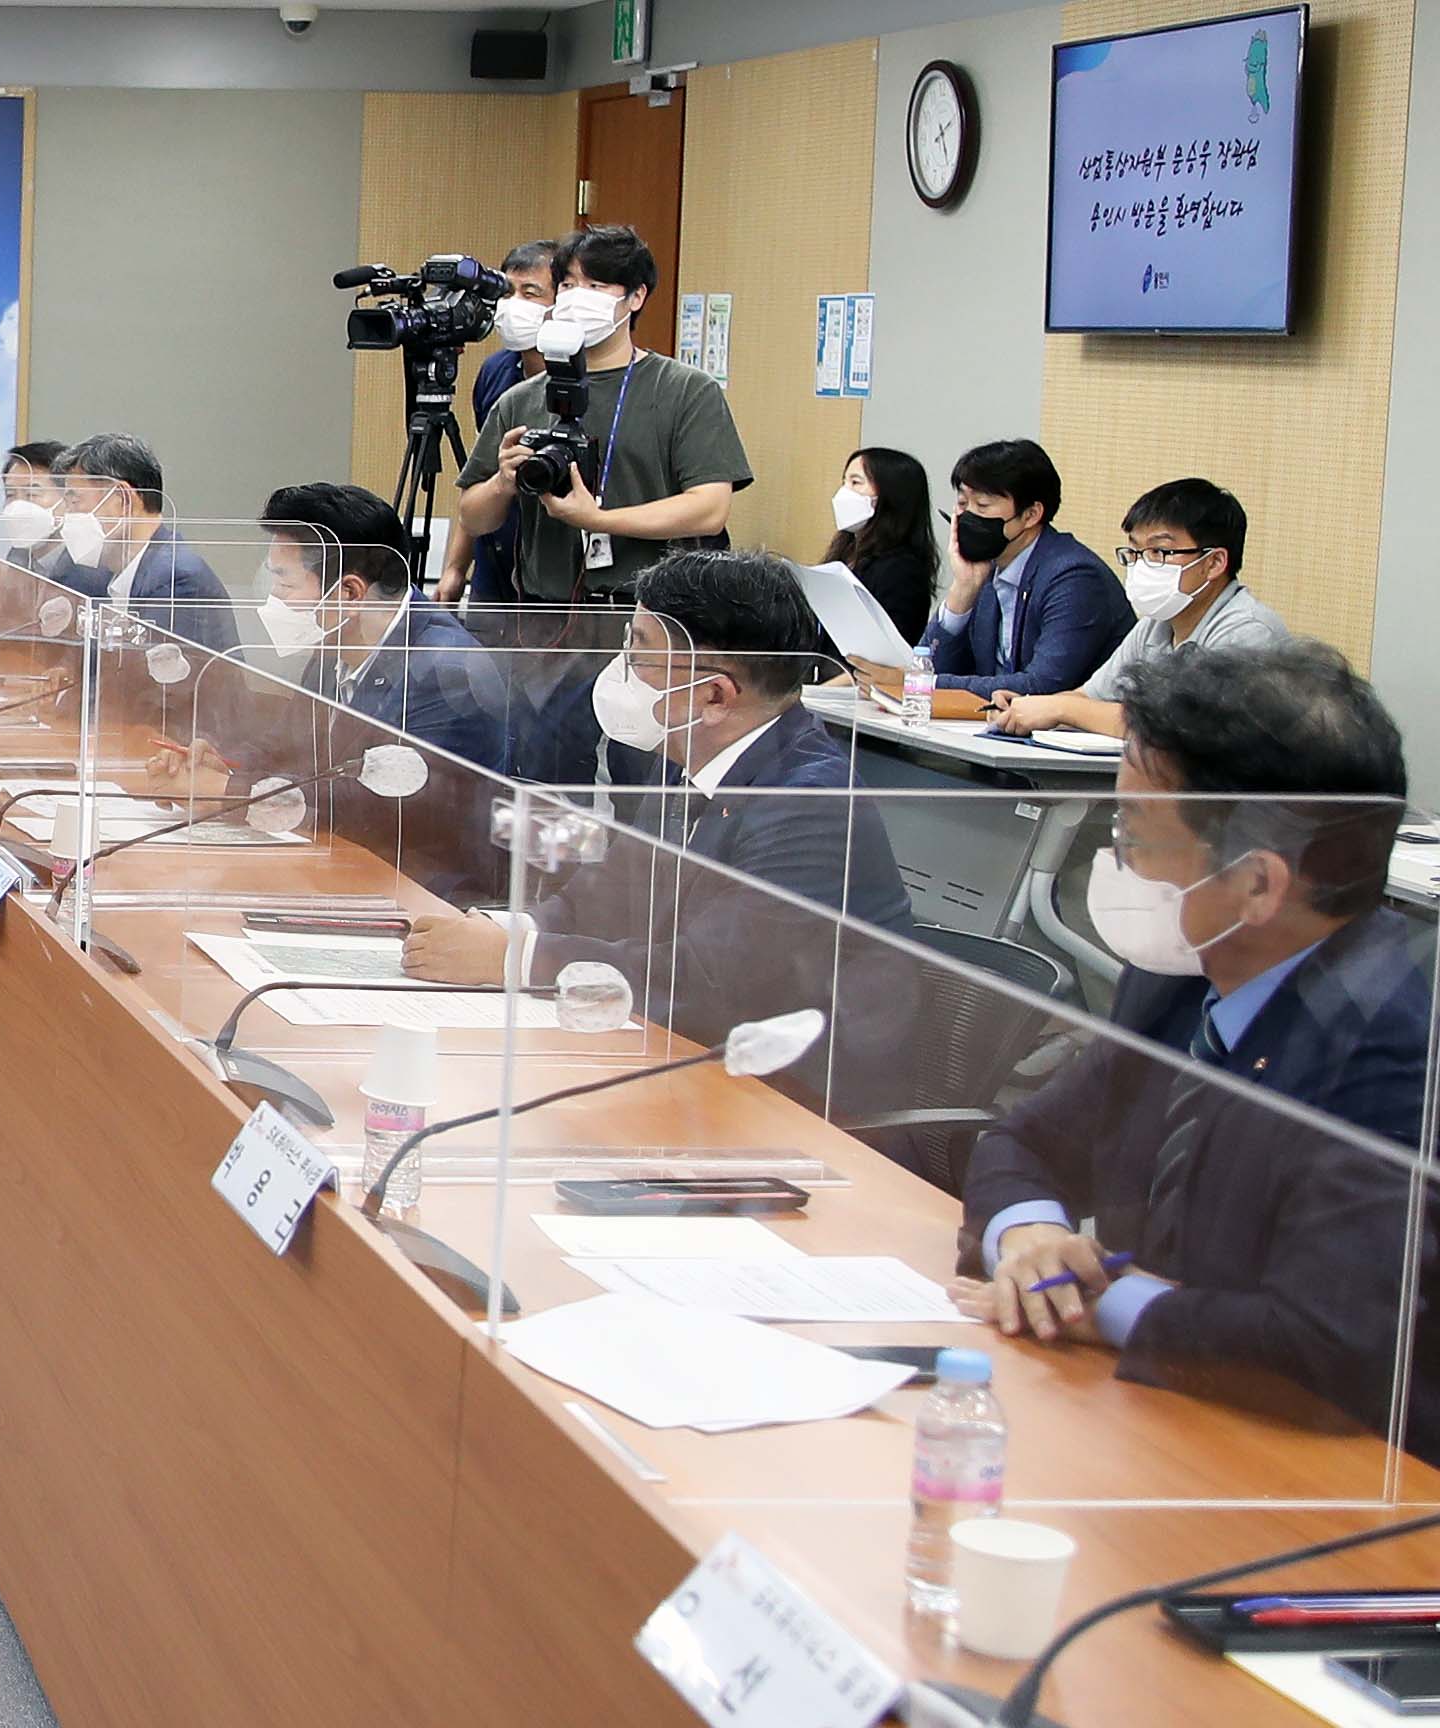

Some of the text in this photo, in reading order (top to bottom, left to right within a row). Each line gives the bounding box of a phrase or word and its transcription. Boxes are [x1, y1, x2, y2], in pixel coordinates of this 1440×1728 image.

[1079, 138, 1261, 182] 산업통상자원부 문승욱 장관님
[1090, 191, 1244, 236] 용인시 방문을 환영합니다
